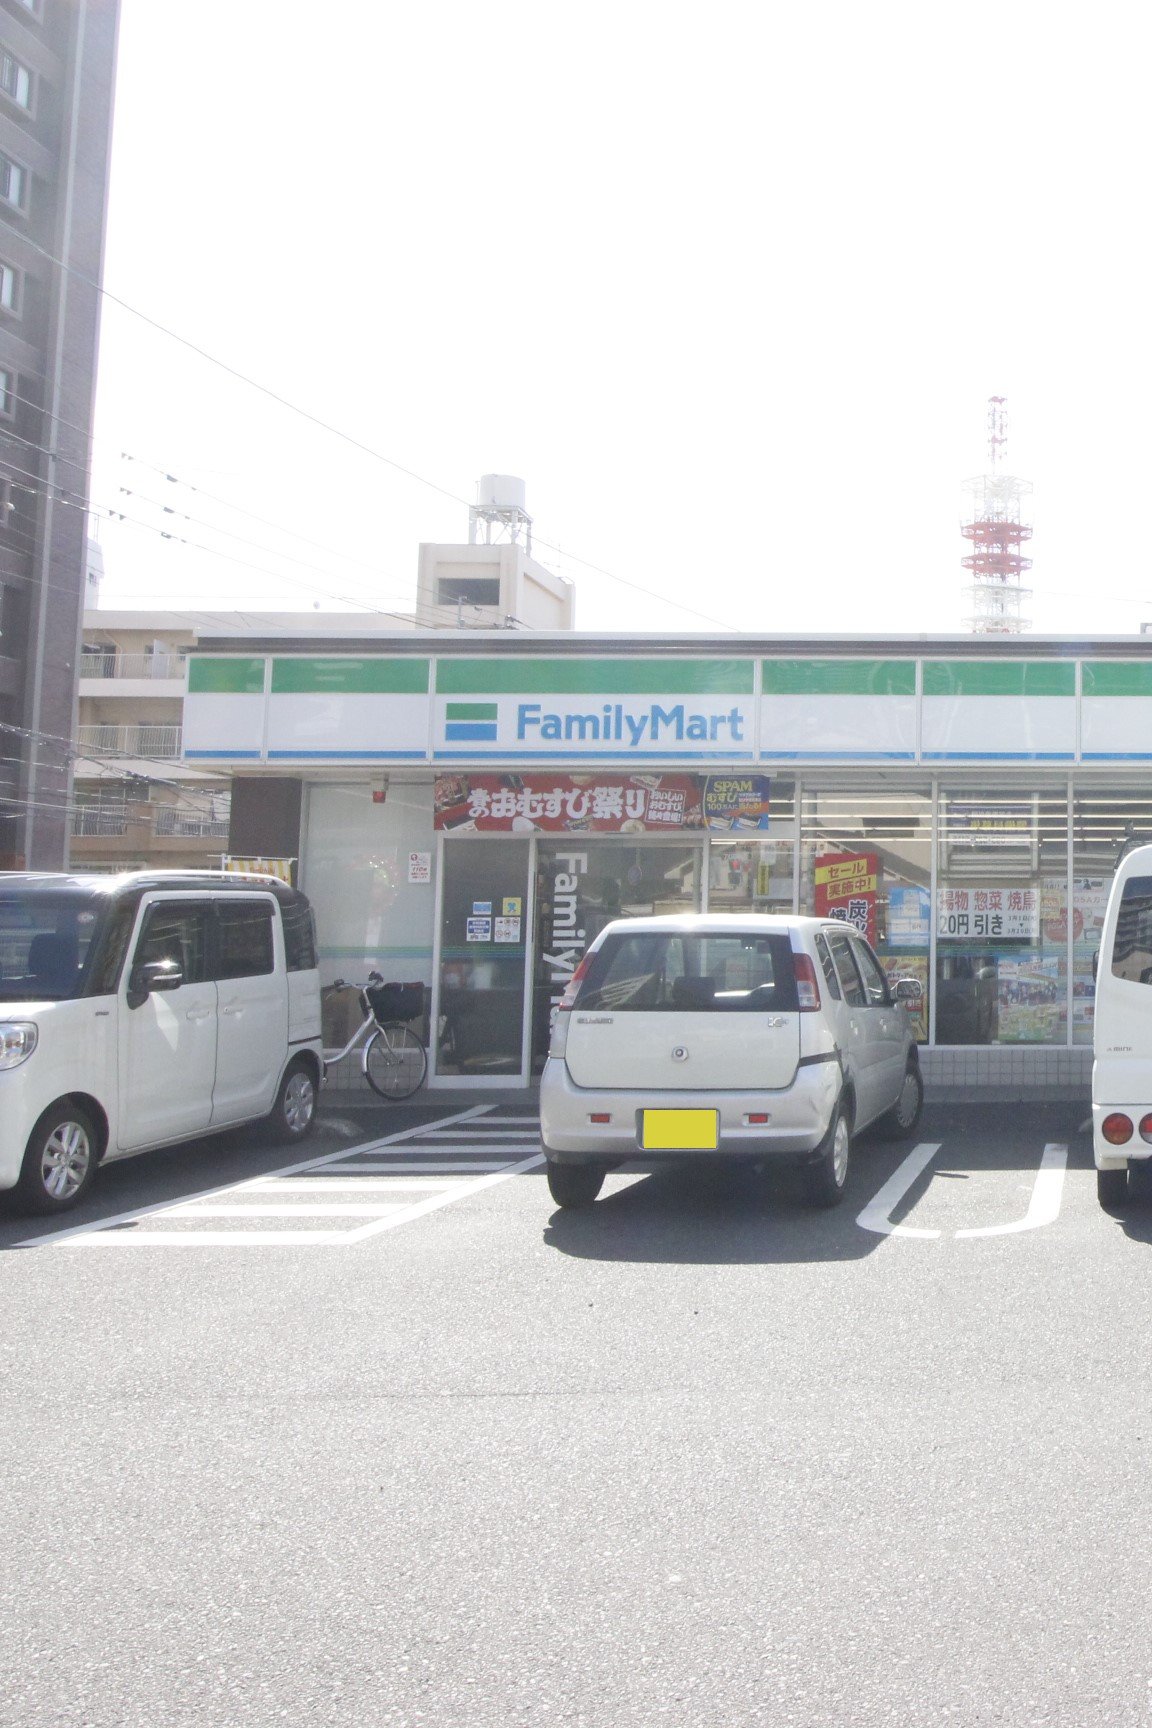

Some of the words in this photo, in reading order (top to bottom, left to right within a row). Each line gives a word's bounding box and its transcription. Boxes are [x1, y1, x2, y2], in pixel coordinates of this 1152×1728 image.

[517, 703, 744, 746] FamilyMart
[713, 780, 753, 792] SPAM
[649, 800, 682, 811] おむすび
[707, 792, 737, 803] むすび
[828, 862, 864, 879] セール
[829, 877, 872, 898] 実施中!
[941, 890, 969, 911] 揚物
[974, 890, 1003, 912] 惣菜
[1008, 890, 1037, 911] 焼鳥
[940, 913, 969, 935] 20円
[974, 913, 1004, 935] 引き
